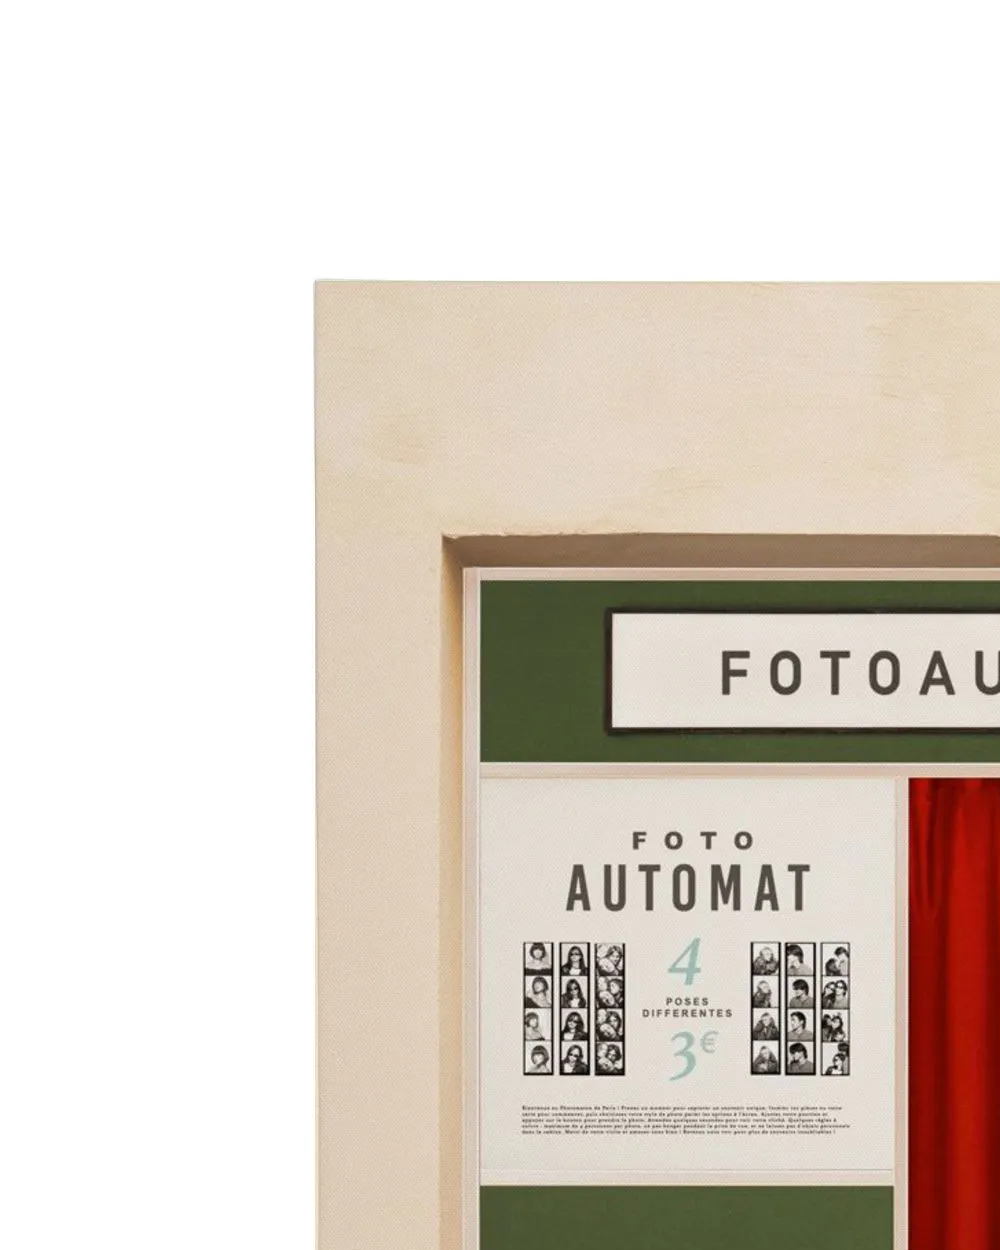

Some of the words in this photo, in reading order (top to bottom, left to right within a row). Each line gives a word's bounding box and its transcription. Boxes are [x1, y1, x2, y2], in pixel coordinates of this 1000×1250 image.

[632, 831, 754, 851] FOTO
[565, 863, 811, 912] AUTOMAT
[667, 936, 702, 986] 4
[642, 1008, 733, 1018] DIFFERENTES
[665, 997, 709, 1006] POSES
[669, 1030, 719, 1082] 3€
